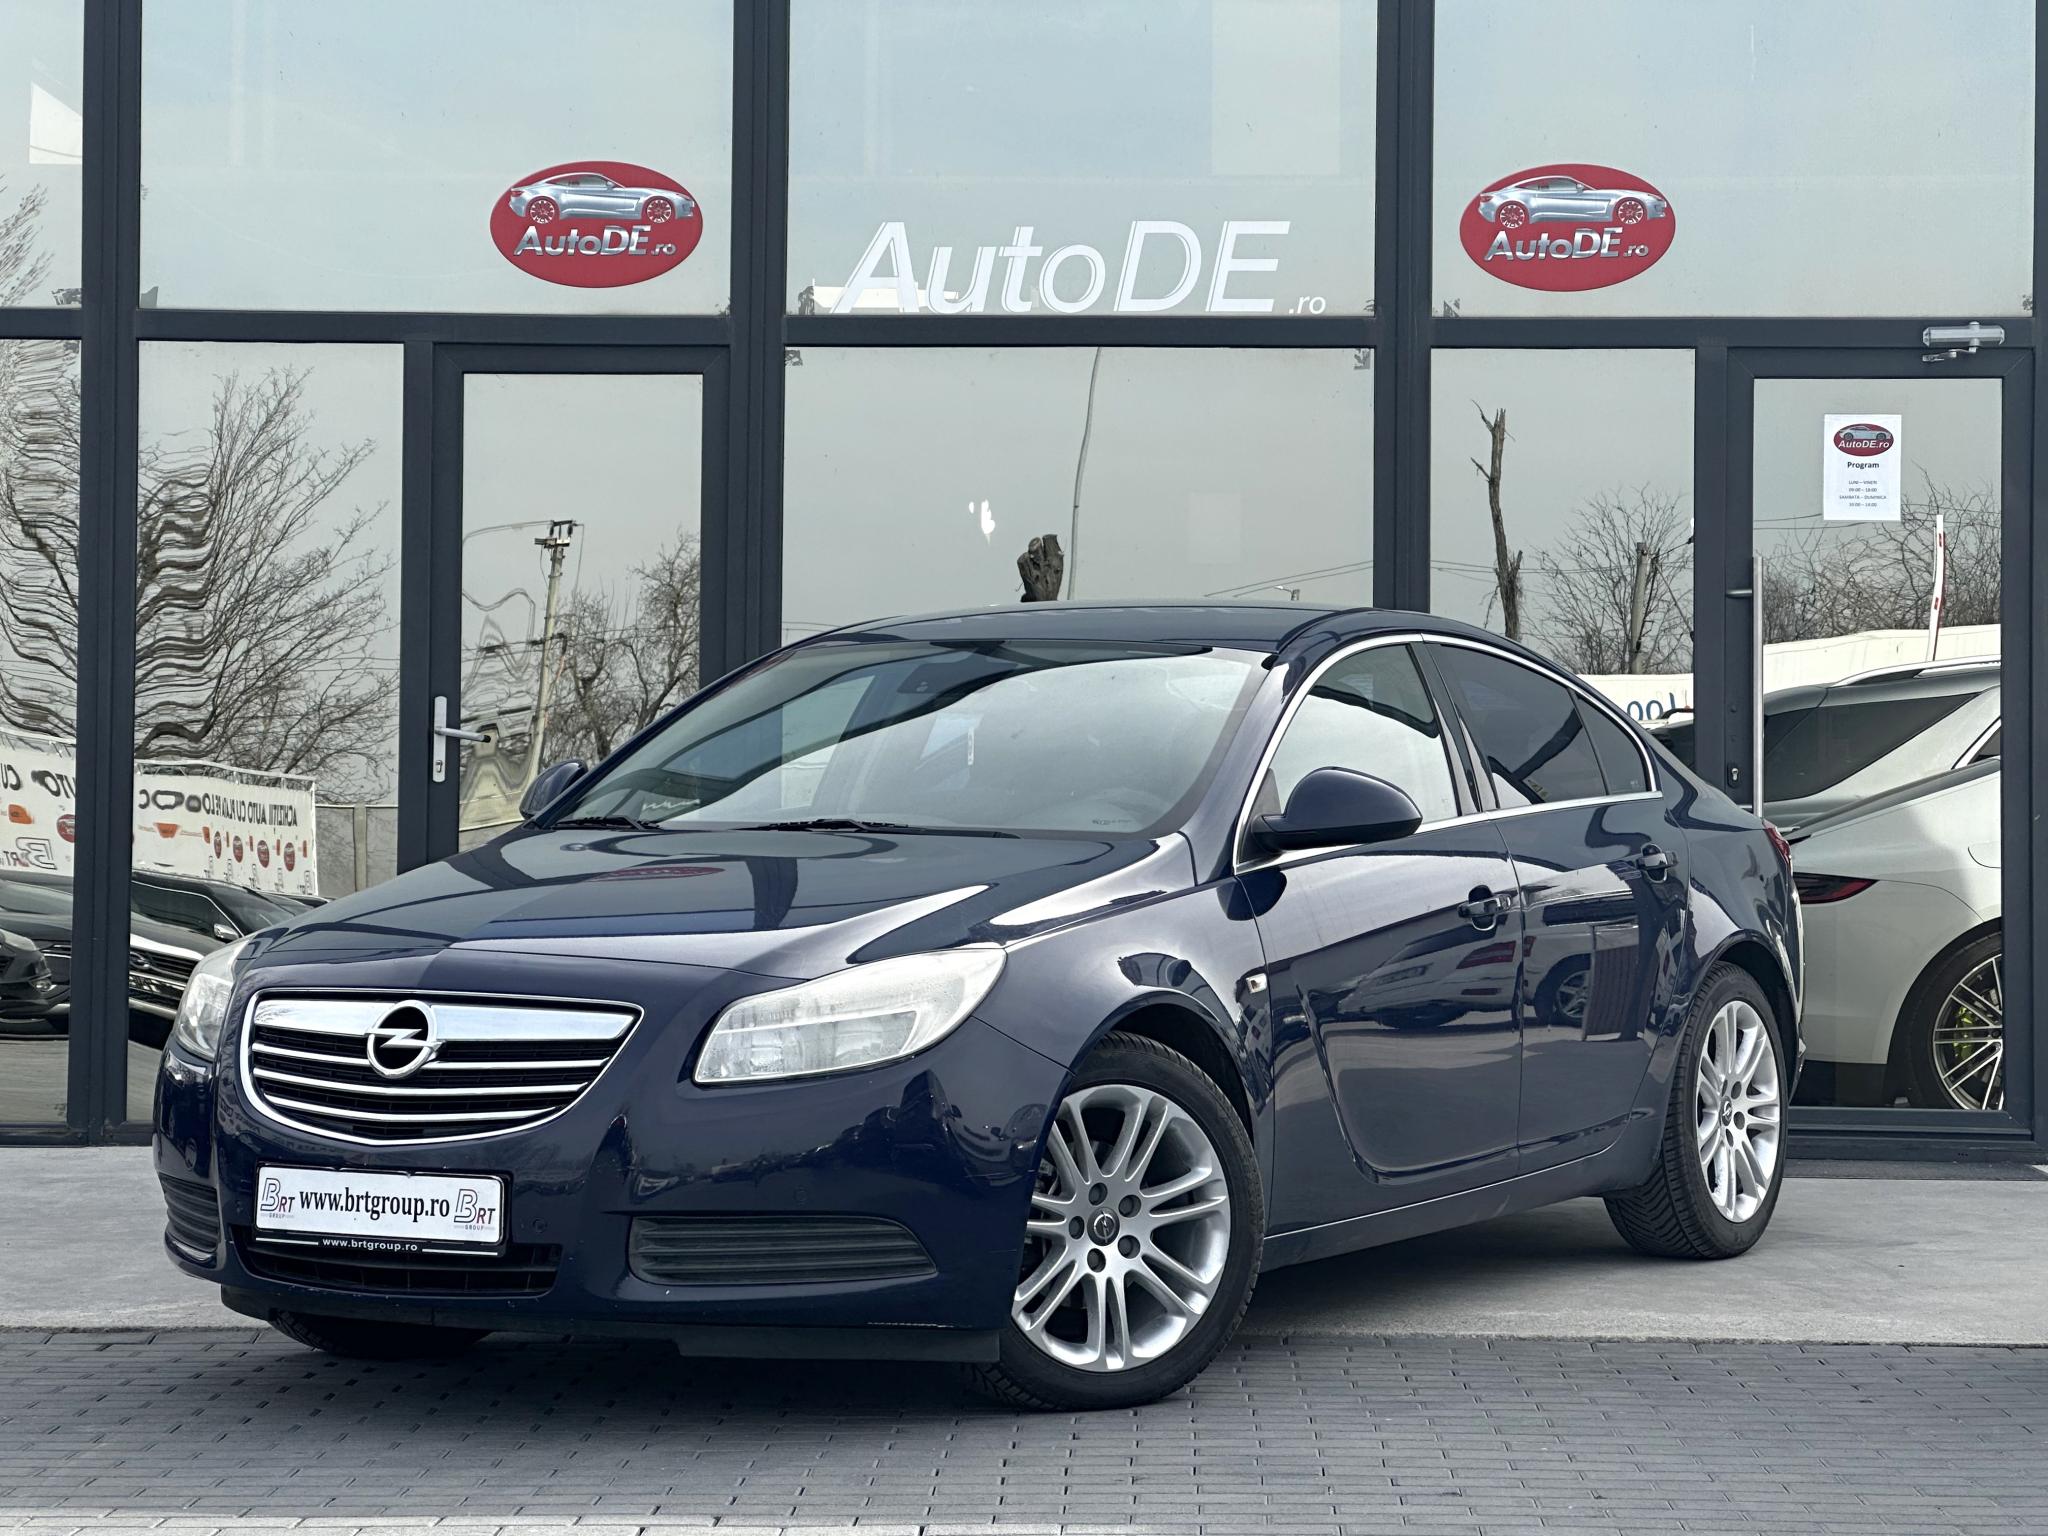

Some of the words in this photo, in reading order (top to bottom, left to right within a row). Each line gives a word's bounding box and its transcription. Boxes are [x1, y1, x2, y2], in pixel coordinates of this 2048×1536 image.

[513, 225, 676, 256] AutoDE.ro
[1484, 227, 1649, 261] AutoDE.ro
[1838, 440, 1890, 448] AutoDE.ro
[1847, 461, 1880, 470] Program
[260, 1177, 295, 1213] BRT
[299, 1186, 450, 1223] www.brtgroup.ro
[453, 1188, 496, 1224] BRT
[322, 1238, 418, 1252] www.brtgroup.ro
